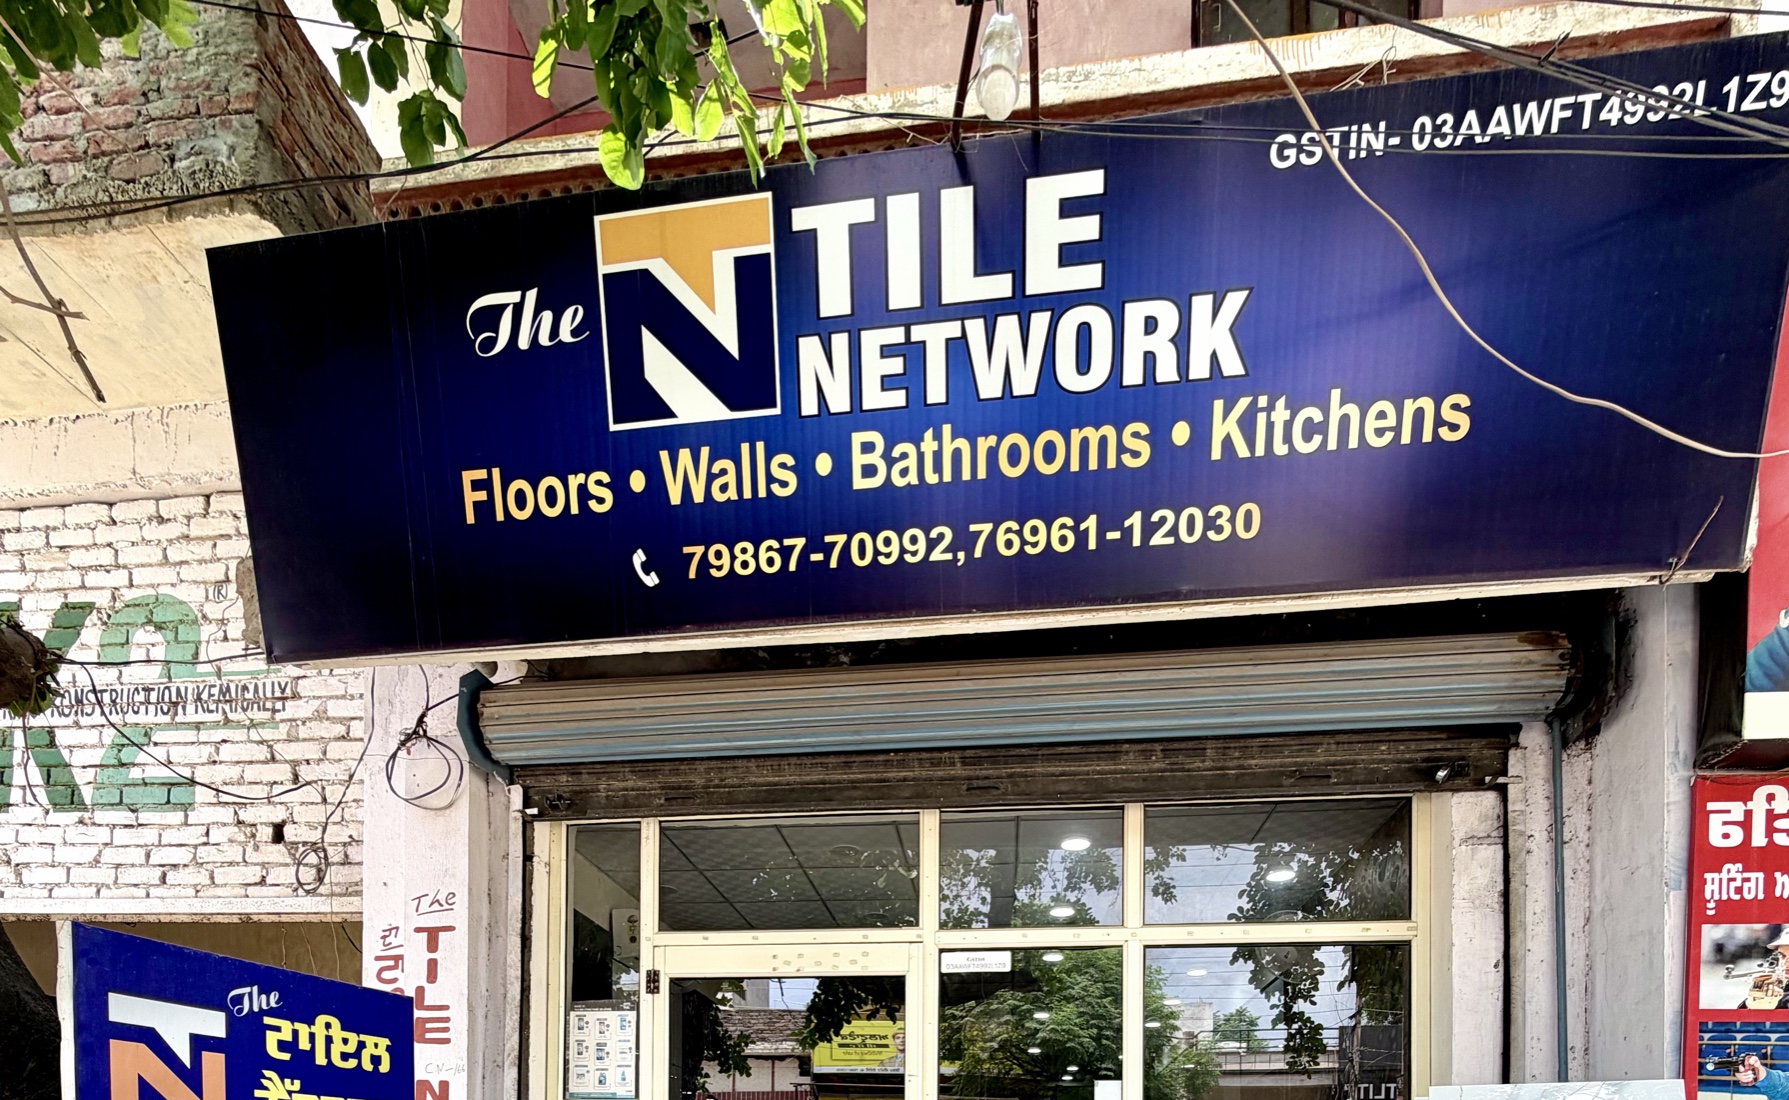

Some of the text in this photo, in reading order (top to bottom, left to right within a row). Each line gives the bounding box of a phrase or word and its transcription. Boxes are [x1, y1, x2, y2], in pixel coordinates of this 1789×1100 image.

[790, 168, 1105, 319] TILE
[466, 287, 590, 357] The
[797, 288, 1252, 418] NETWORK
[461, 388, 1472, 524] Floors Walls Bathrooms Kitchens
[411, 889, 456, 913] The
[228, 985, 283, 1017] The
[413, 926, 456, 1044] TILE
[263, 1014, 392, 1074] ਟਾਇਲ
